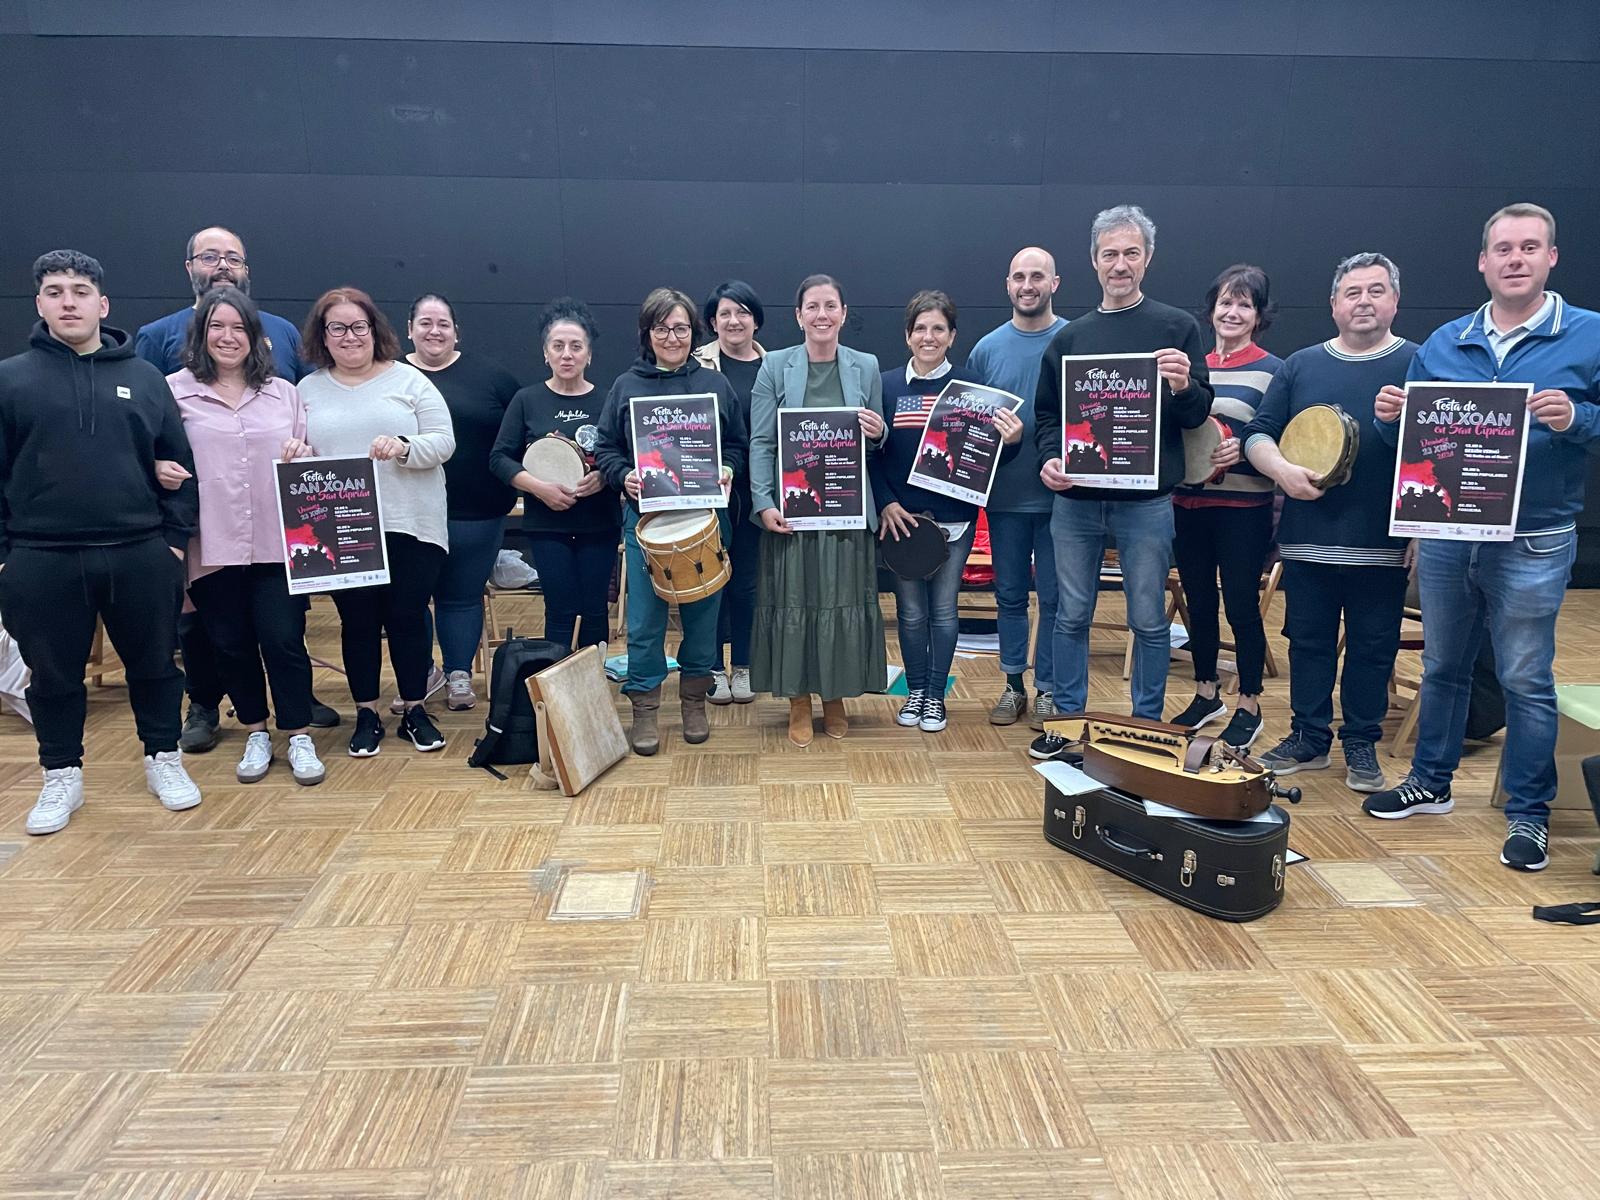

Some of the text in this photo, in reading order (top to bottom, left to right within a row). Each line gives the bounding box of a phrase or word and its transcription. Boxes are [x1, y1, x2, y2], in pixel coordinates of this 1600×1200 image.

[1086, 368, 1120, 380] Festa de
[1074, 378, 1147, 392] SAN XOÁN
[1100, 388, 1118, 399] San
[946, 396, 968, 408] SAN
[1432, 398, 1477, 412] Festa de
[652, 407, 672, 416] Festa
[643, 416, 667, 425] SAN
[1417, 410, 1512, 426] SAN XOÁN
[799, 420, 819, 430] Festa
[1448, 422, 1472, 434] San
[1474, 424, 1515, 438] Ciprián
[790, 431, 812, 441] SAN
[300, 470, 336, 482] Festa de
[290, 478, 365, 495] SAN XOÁN
[318, 490, 336, 500] San
